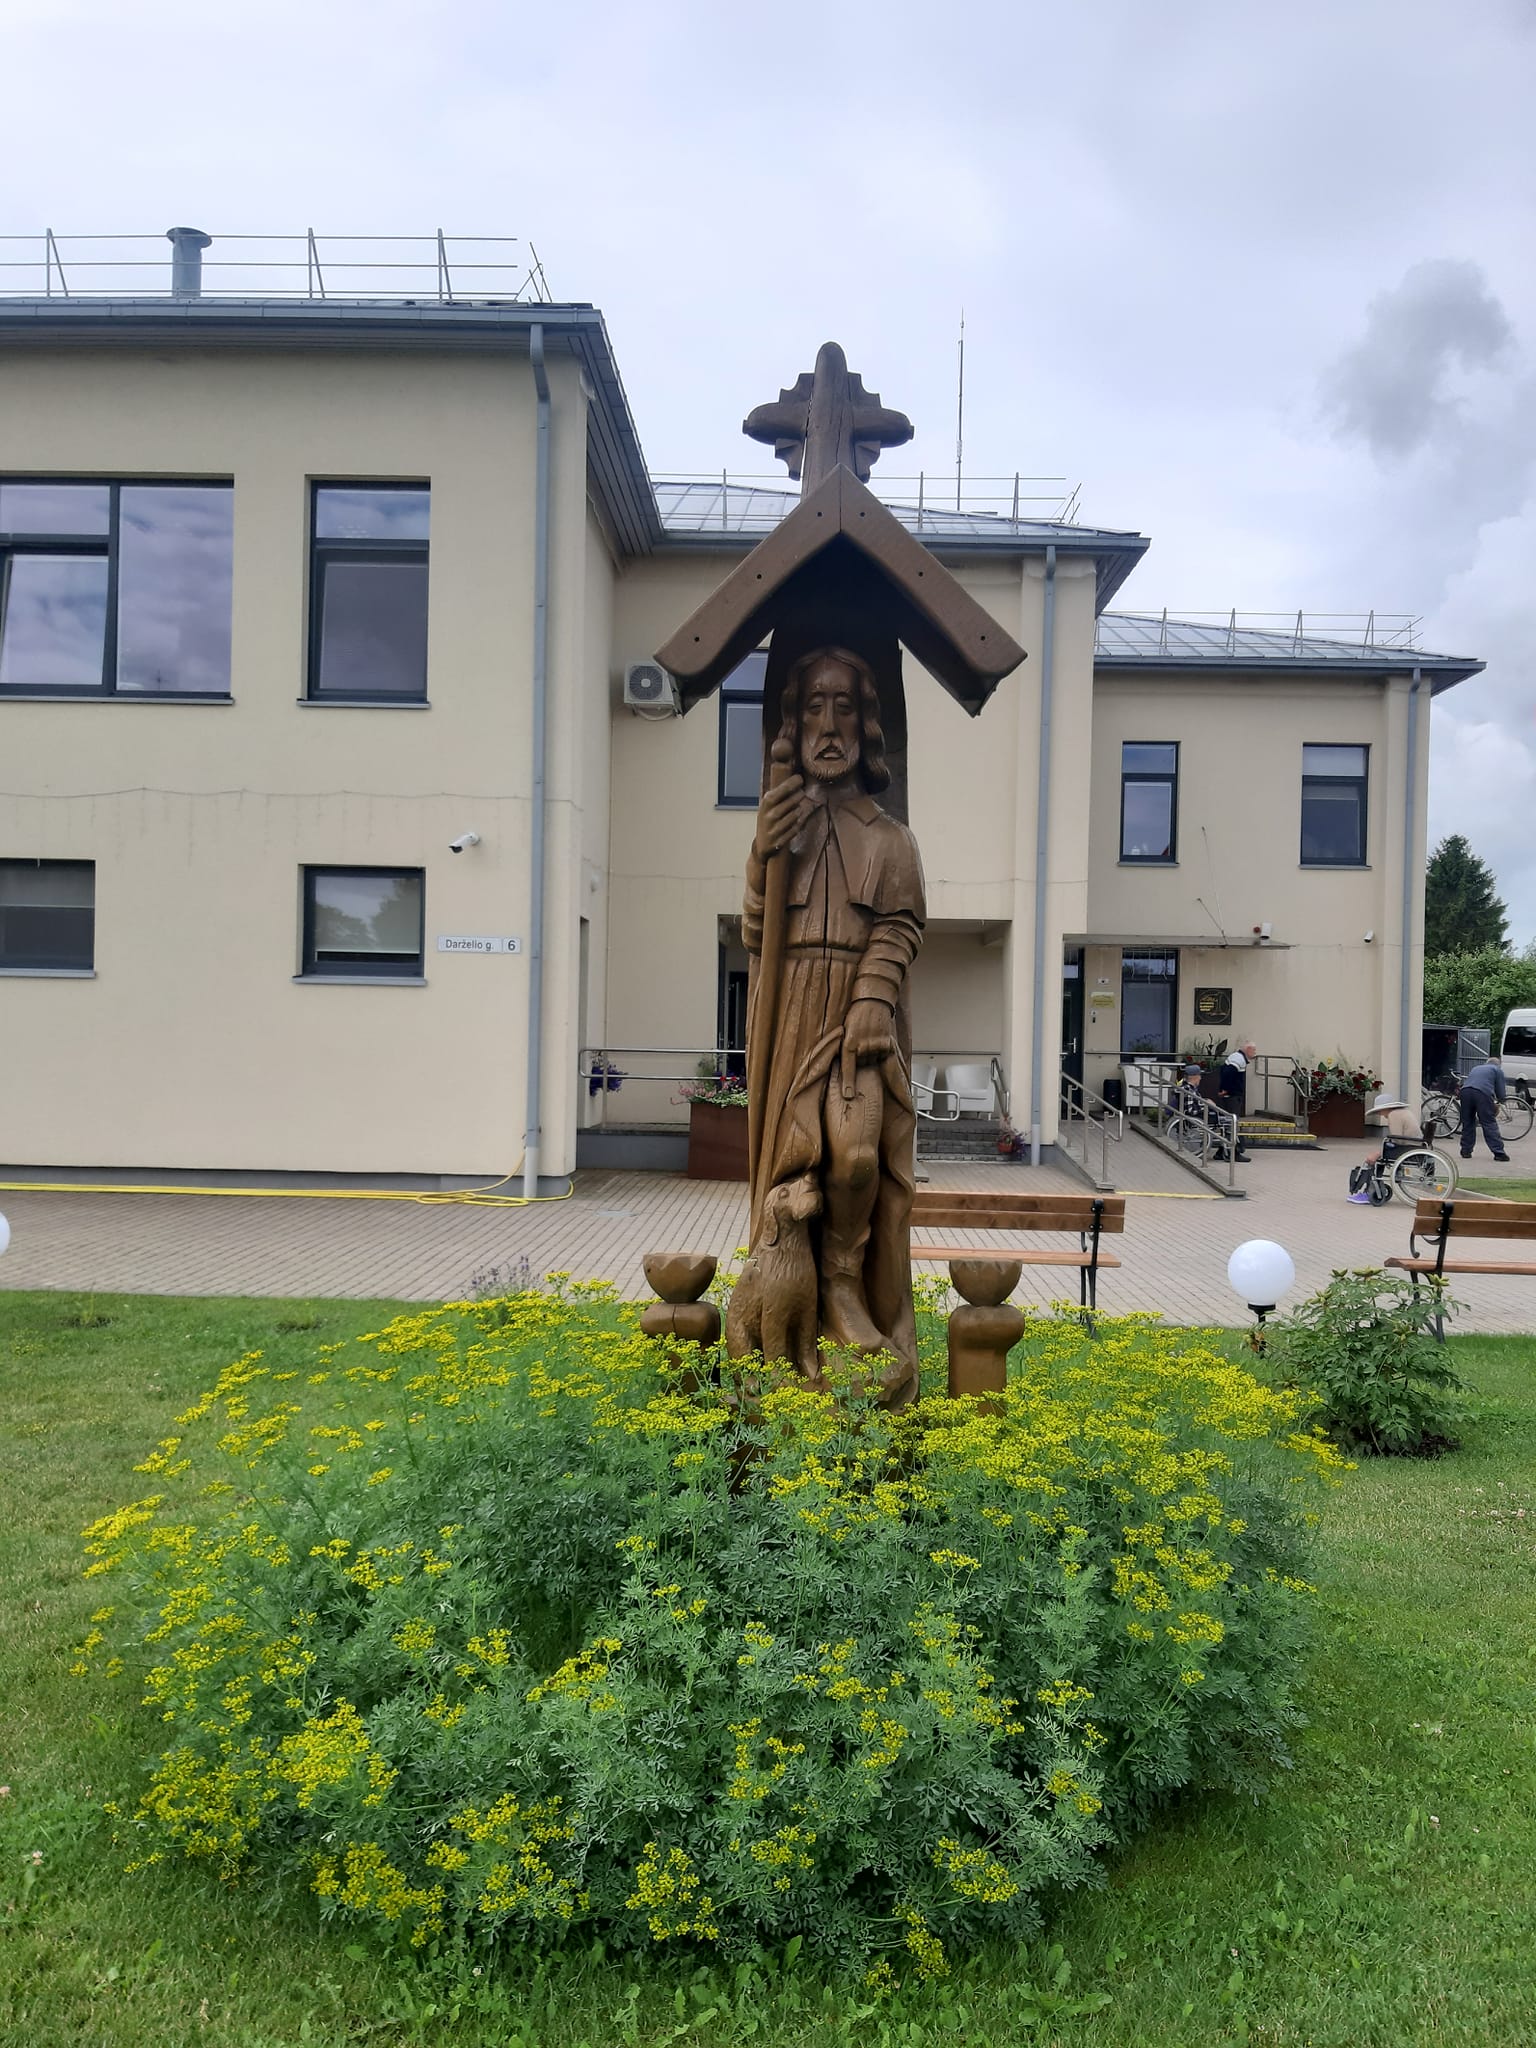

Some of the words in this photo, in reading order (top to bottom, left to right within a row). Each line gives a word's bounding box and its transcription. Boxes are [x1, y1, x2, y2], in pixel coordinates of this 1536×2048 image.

[445, 939, 483, 949] Darželio
[485, 942, 494, 951] g.
[508, 939, 516, 951] 6
